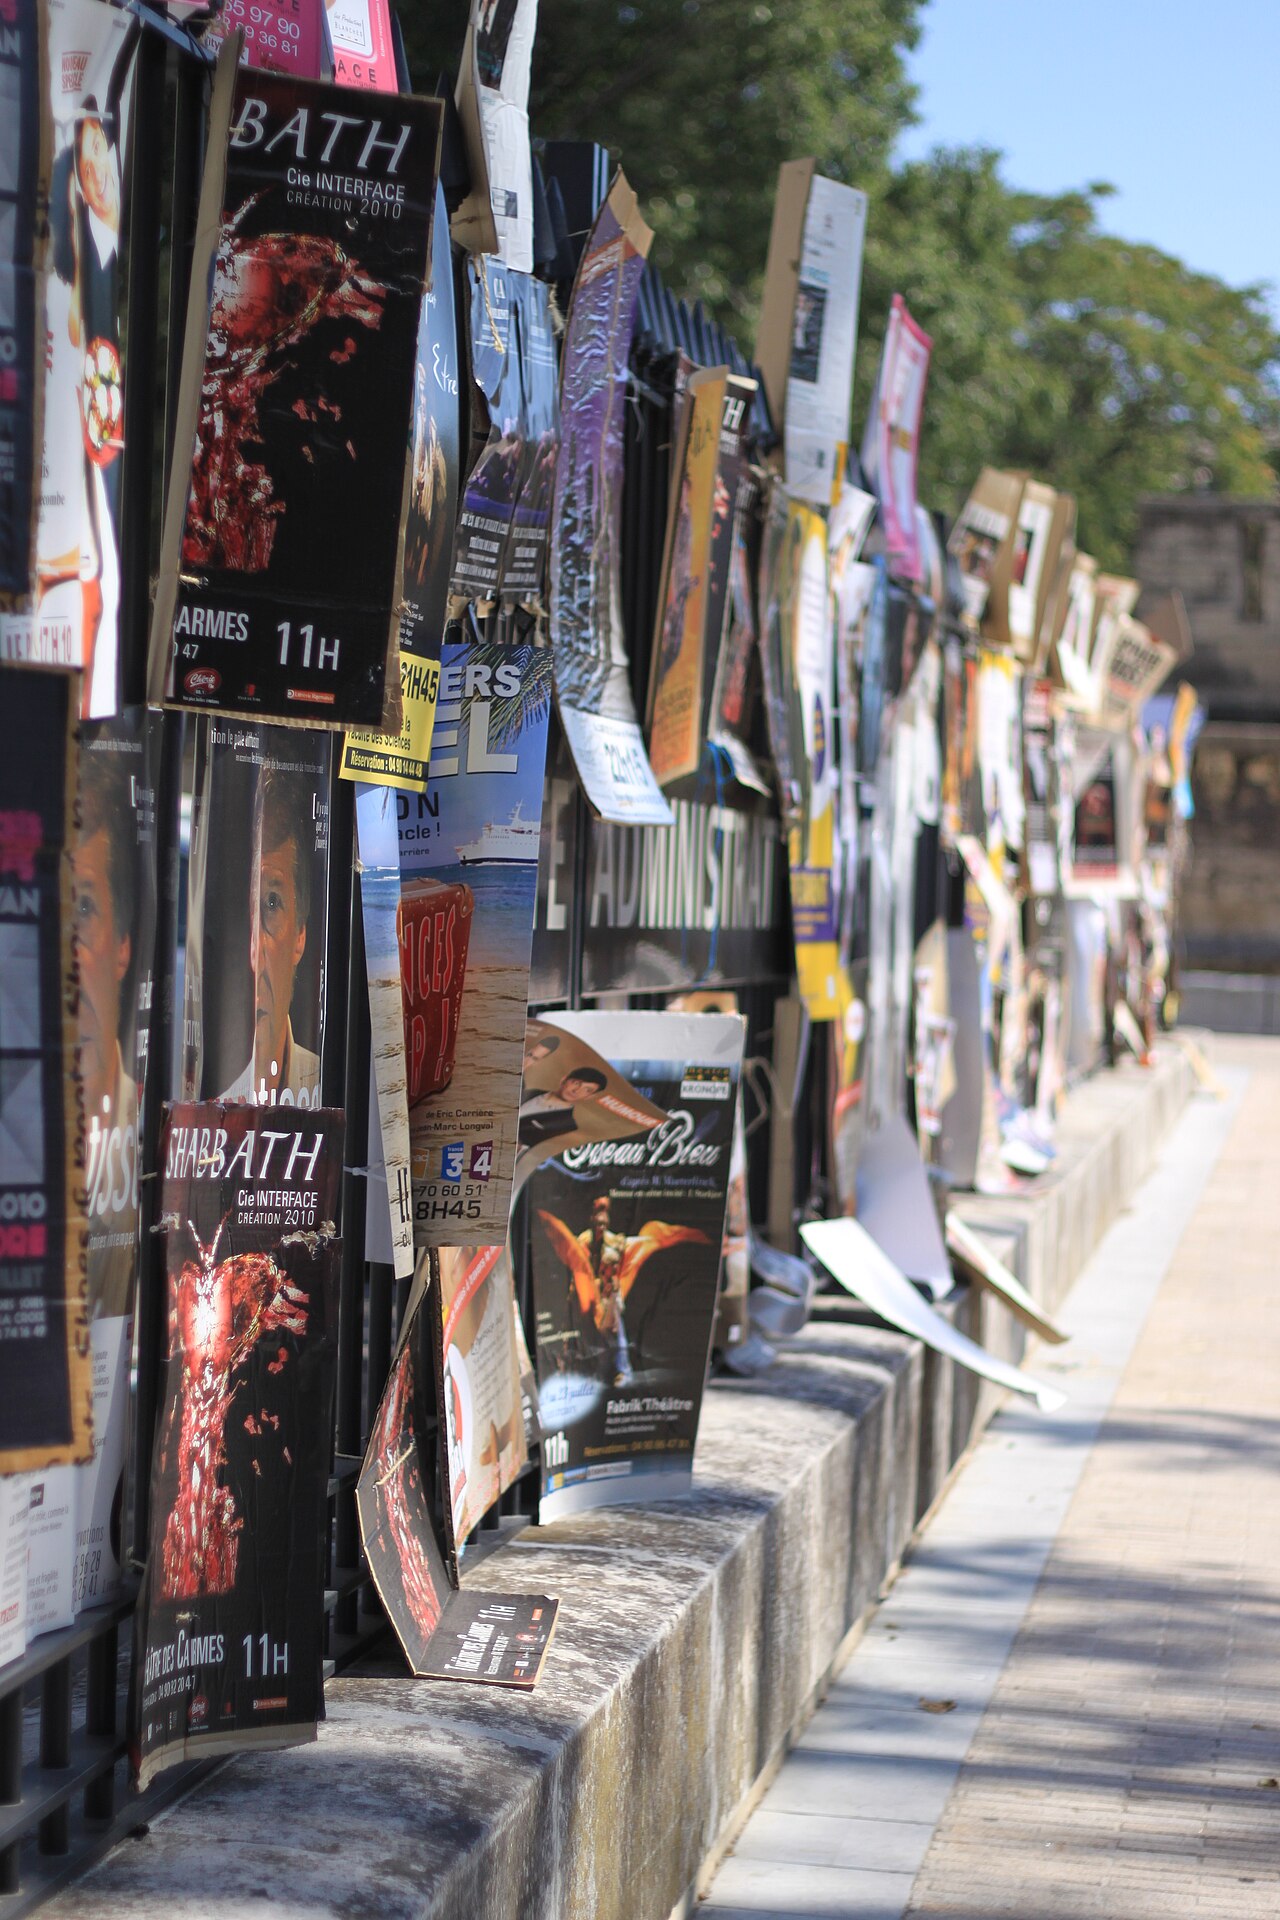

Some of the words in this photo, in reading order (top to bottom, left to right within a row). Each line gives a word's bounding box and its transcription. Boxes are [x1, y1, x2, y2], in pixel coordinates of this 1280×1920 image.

[250, 6, 273, 27] 97
[277, 17, 300, 39] 90
[258, 31, 277, 48] 36
[281, 40, 299, 57] 81
[229, 97, 411, 174] BATH
[287, 167, 311, 186] Cie
[316, 173, 406, 202] INTERFACE
[287, 190, 351, 211] CRÉATION
[359, 198, 402, 219] 2010
[173, 605, 250, 642] ARMES
[182, 644, 199, 660] 47
[277, 621, 340, 671] 11H
[440, 664, 521, 701] ERS
[350, 750, 385, 771] Réservation
[0, 885, 40, 918] AN
[436, 1110, 454, 1119] Eric
[456, 1108, 494, 1119] Carrière
[459, 1121, 494, 1132] Longval
[165, 1127, 324, 1181] SHABBATH
[445, 1153, 463, 1178] 3
[473, 1151, 490, 1177] 4
[238, 1189, 254, 1207] Cie
[256, 1190, 318, 1208] INTERFACE
[419, 1185, 437, 1197] 70
[441, 1184, 461, 1197] 60
[238, 1210, 281, 1225] CRÉATION
[284, 1209, 315, 1226] 2010
[176, 1629, 224, 1670] CARMES
[242, 1633, 288, 1677] 11H
